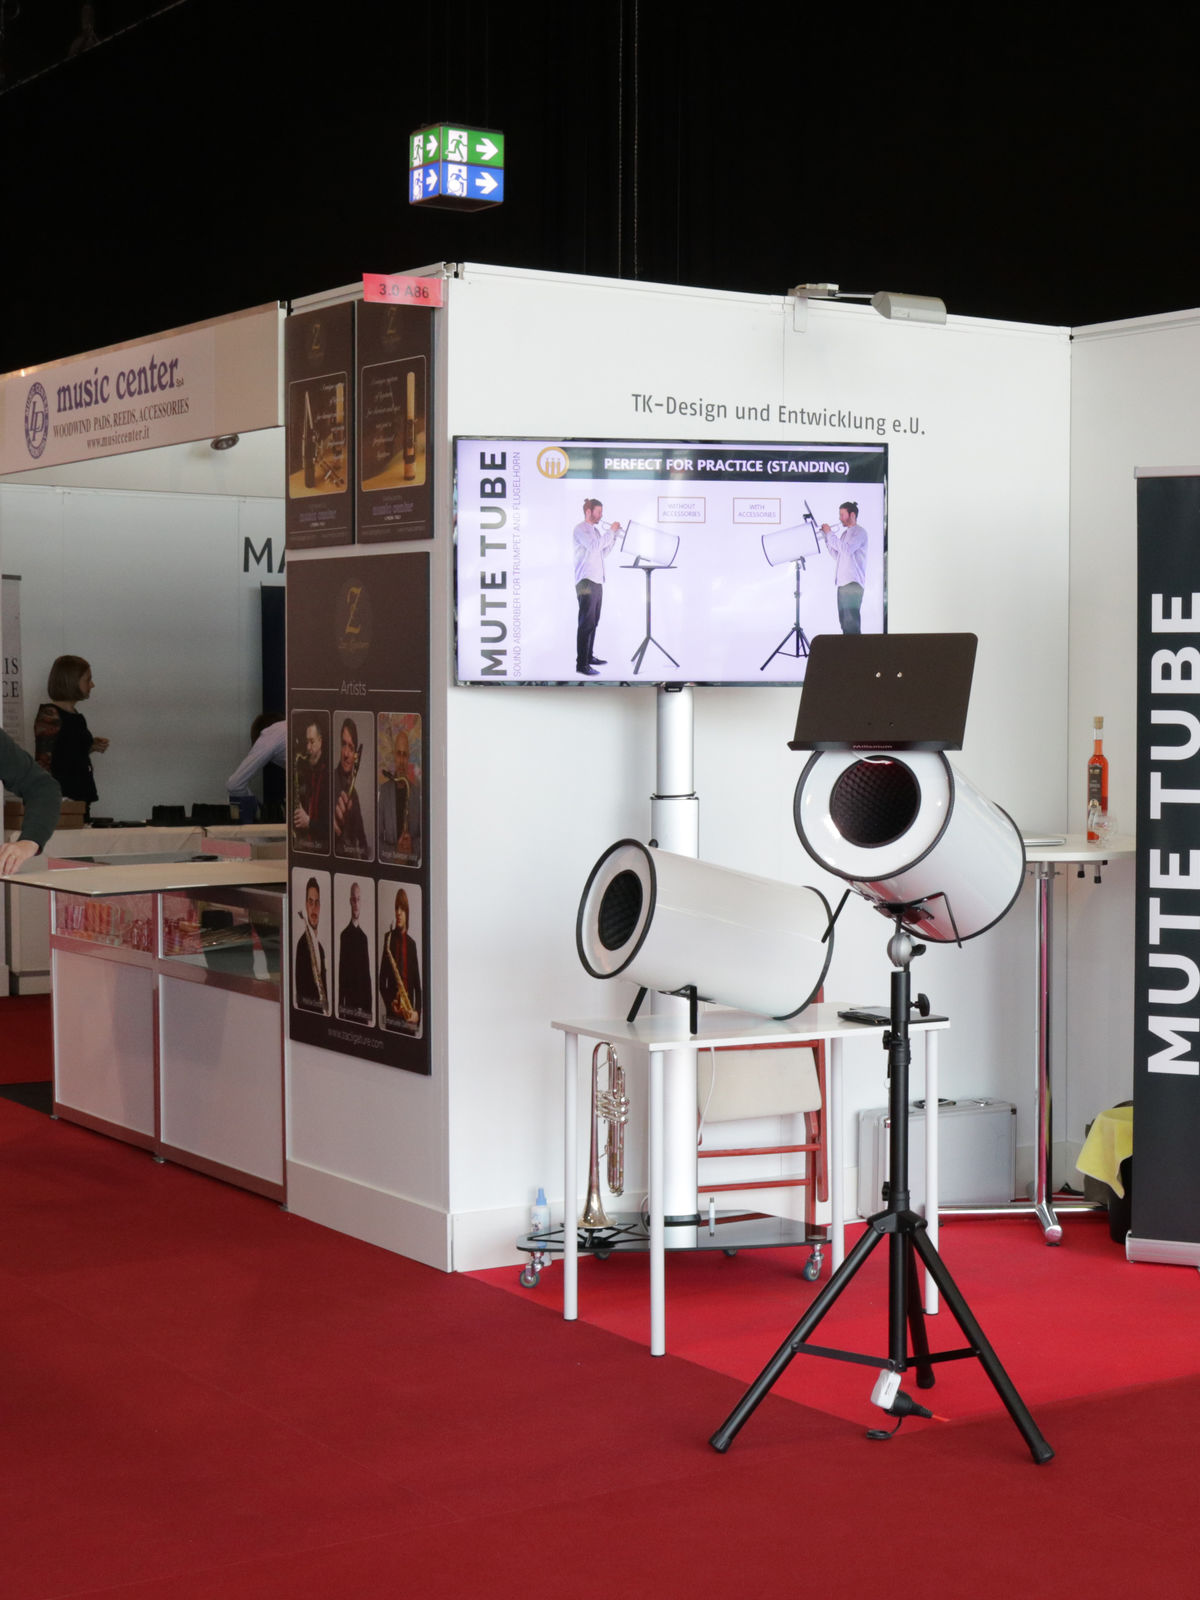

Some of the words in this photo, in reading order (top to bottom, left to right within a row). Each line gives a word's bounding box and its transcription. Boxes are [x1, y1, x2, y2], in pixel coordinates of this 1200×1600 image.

[379, 284, 400, 297] 3.0
[404, 286, 430, 299] A86
[56, 366, 110, 413] music
[116, 354, 179, 400] center
[53, 417, 92, 438] WOODWIND
[94, 414, 113, 432] PADS,
[113, 409, 139, 428] REEDS,
[140, 397, 190, 423] ACCESSORIES
[631, 393, 728, 423] TK-Design
[735, 403, 771, 422] und
[778, 405, 887, 436] Entwicklung
[892, 416, 926, 436] e.U.
[87, 425, 150, 449] www.musiccenter.it
[513, 451, 522, 511] FLUGELHORN
[604, 458, 661, 473] PERFECT
[665, 458, 694, 473] FOR
[697, 459, 763, 474] PRACTICE
[767, 459, 850, 476] (STANDING)
[480, 451, 507, 557] TUBE
[662, 510, 701, 518] ACCESSORIES
[738, 511, 777, 519] ACCESSORIES
[749, 503, 765, 511] WITH
[513, 512, 522, 532] AND
[513, 534, 522, 576] TRUMPET
[513, 577, 522, 596] FOR
[480, 571, 508, 677] MUTE
[513, 598, 522, 644] ABSORBER
[513, 645, 522, 678] SOUND
[340, 680, 367, 696] Artists
